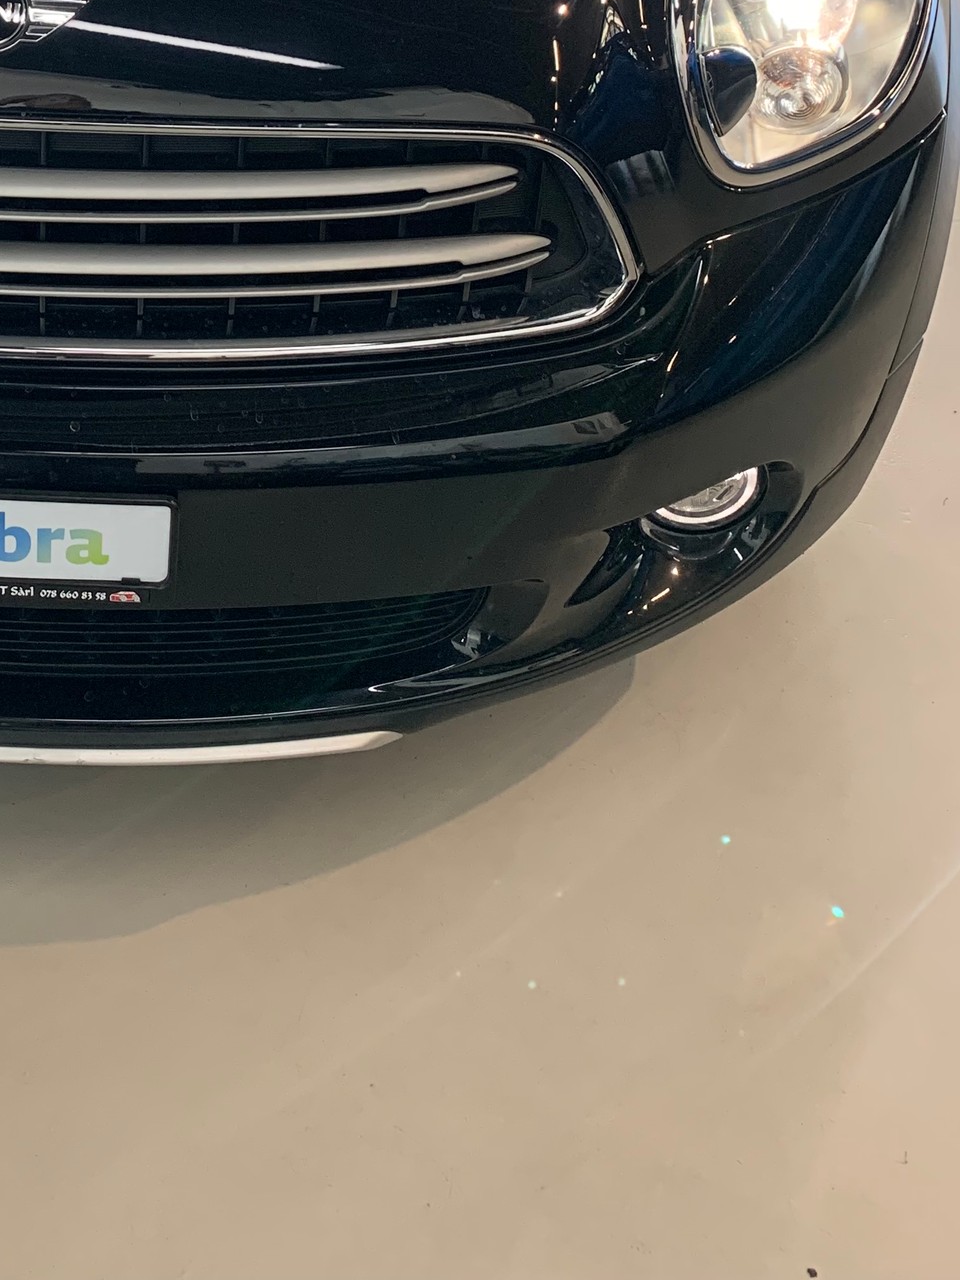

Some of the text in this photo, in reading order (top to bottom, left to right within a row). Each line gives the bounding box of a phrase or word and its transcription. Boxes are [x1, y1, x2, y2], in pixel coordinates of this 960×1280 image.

[40, 589, 57, 598] 078
[59, 590, 79, 600] 660
[81, 591, 92, 600] 83
[95, 592, 106, 600] 58
